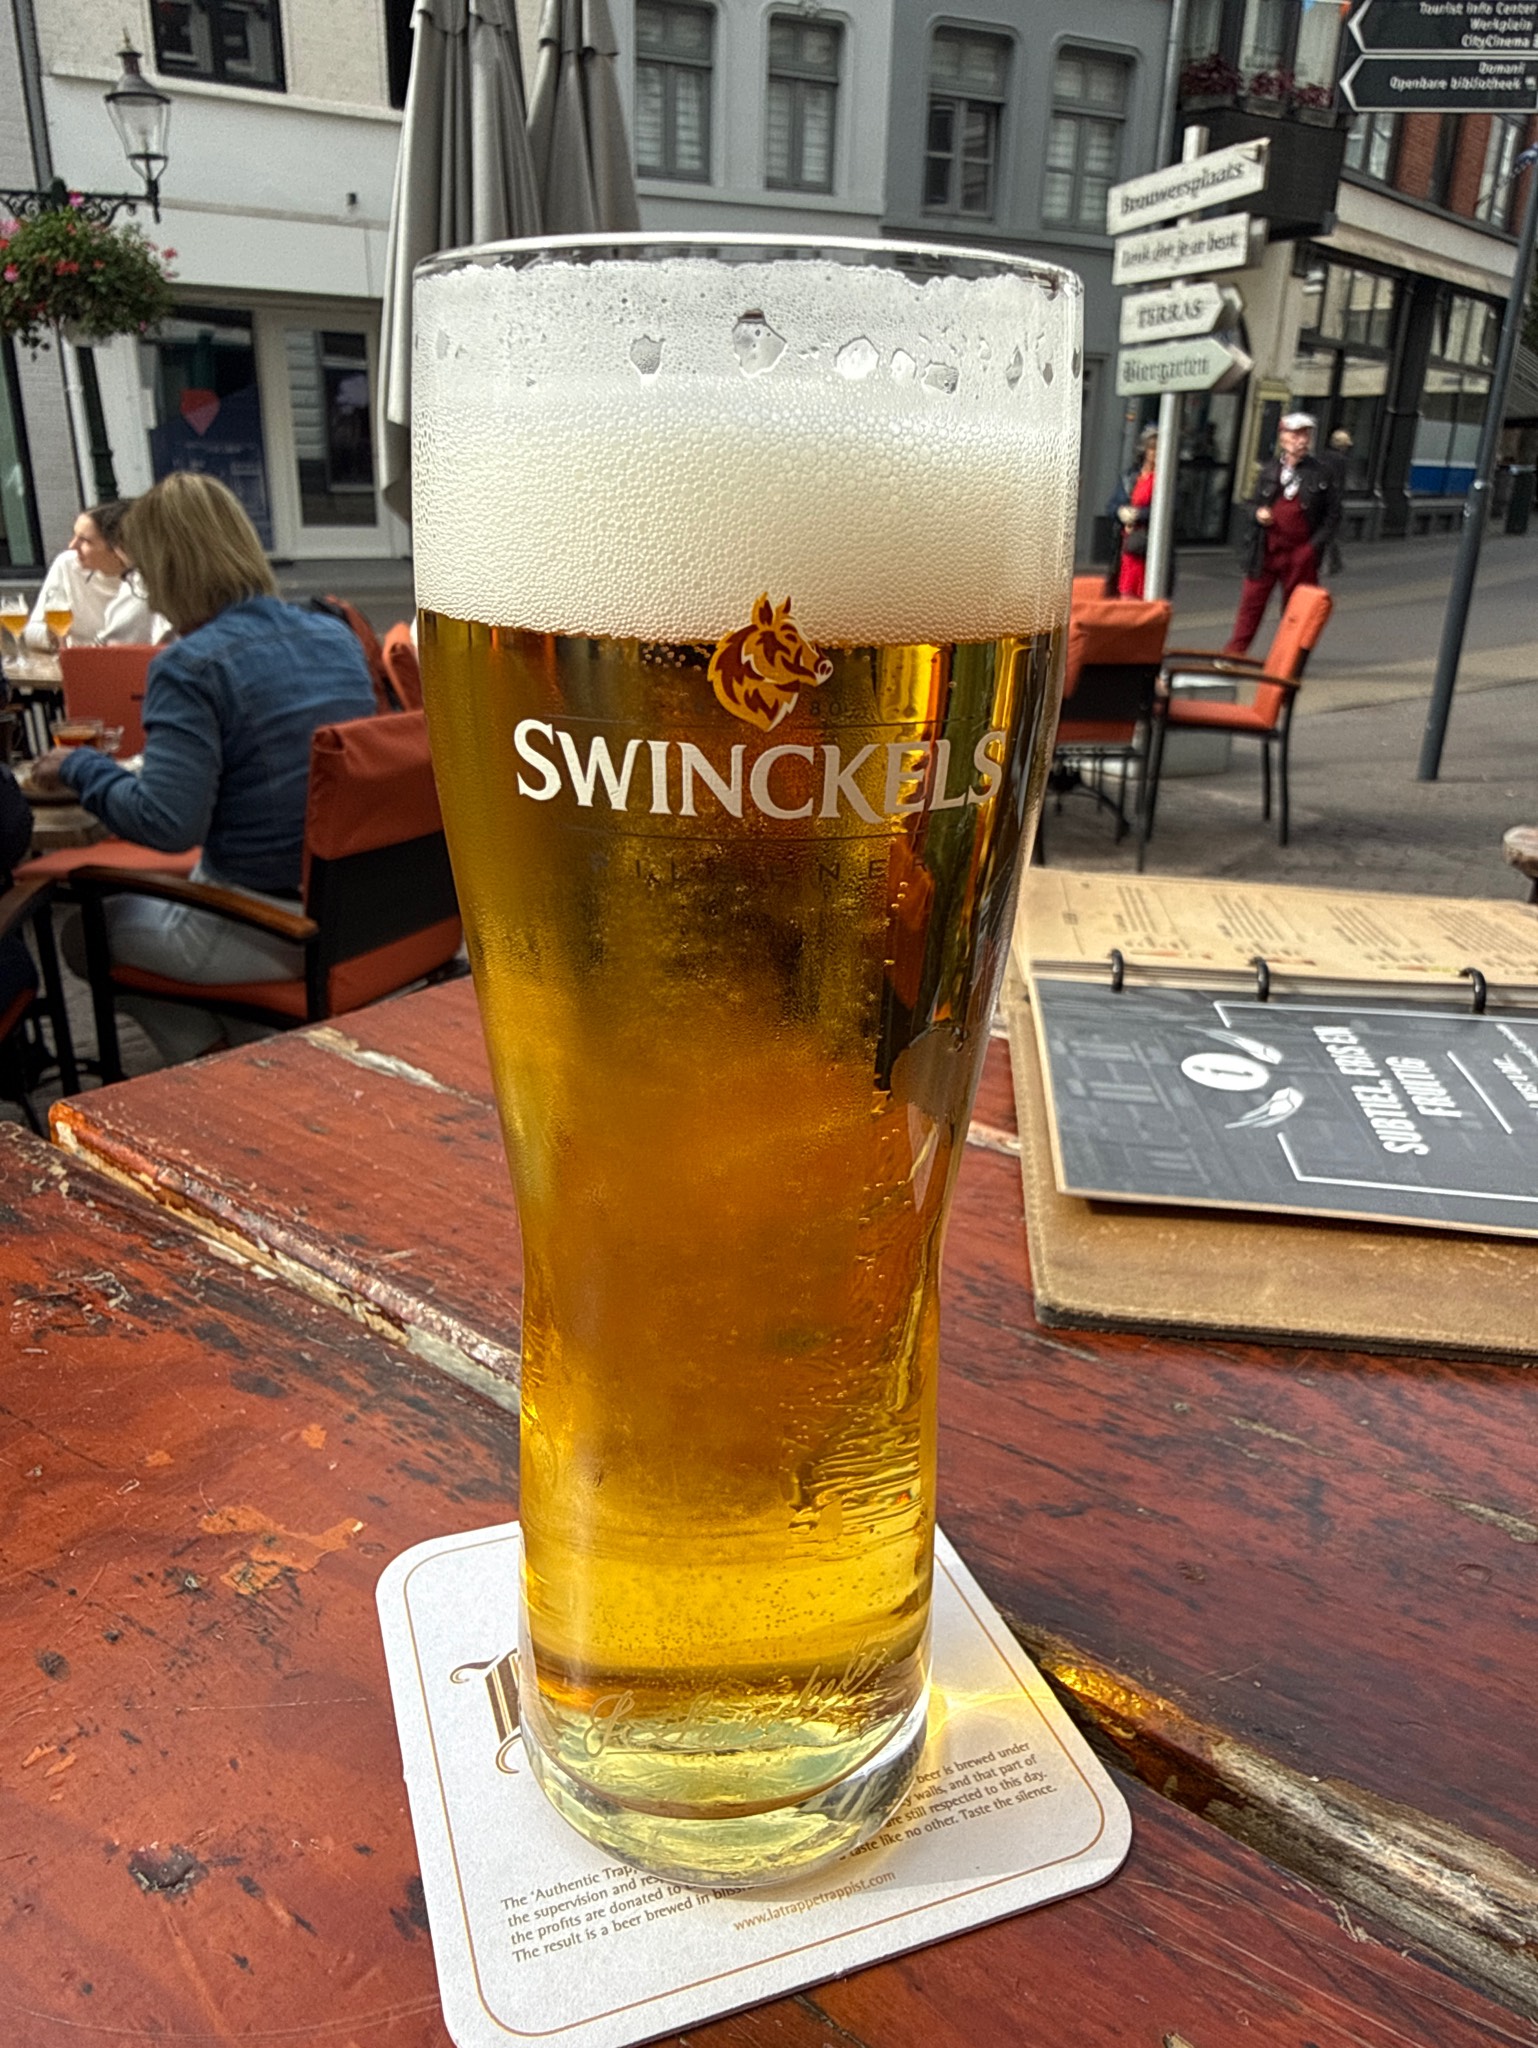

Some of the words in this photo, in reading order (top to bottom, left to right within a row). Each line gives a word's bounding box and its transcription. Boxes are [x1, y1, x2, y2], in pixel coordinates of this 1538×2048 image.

[1420, 1, 1463, 15] Tourist
[1495, 1, 1537, 15] Center
[1390, 76, 1448, 92] Openbare
[1451, 76, 1521, 90] bibliotheek
[1121, 162, 1245, 215] Brouwersplaats
[1138, 299, 1203, 330] TERRAS
[1123, 356, 1209, 385] Biergarten
[513, 718, 1008, 824] SWINCKELS
[1326, 1044, 1382, 1077] FRIS
[1385, 1056, 1462, 1118] FRUITIG
[1351, 1079, 1430, 1155] SUBTIEL,
[501, 1894, 527, 1911] The
[916, 1770, 942, 1783] beer
[944, 1764, 954, 1777] is
[954, 1752, 996, 1773] brewed
[999, 1741, 1031, 1759] under
[508, 1913, 531, 1927] the
[534, 1889, 609, 1919] supervision
[612, 1877, 637, 1898] and
[914, 1782, 948, 1801] walls,
[949, 1775, 971, 1791] and
[973, 1767, 998, 1784] that
[1000, 1760, 1024, 1778] part
[1025, 1754, 1038, 1766] of
[511, 1930, 534, 1945] the
[537, 1913, 582, 1942] profits
[585, 1908, 607, 1922] are
[609, 1889, 665, 1916] donated
[667, 1883, 682, 1899] to
[906, 1804, 928, 1822] still
[930, 1787, 984, 1814] respected
[985, 1782, 999, 1796] to
[1000, 1775, 1023, 1793] this
[1024, 1769, 1048, 1788] day.
[512, 1948, 540, 1963] The
[544, 1932, 583, 1953] result
[585, 1927, 598, 1941] is
[601, 1925, 610, 1937] a
[612, 1914, 641, 1933] beer
[644, 1895, 693, 1922] brewed
[697, 1891, 711, 1906] in
[881, 1829, 904, 1847] like
[905, 1825, 922, 1840] no
[924, 1813, 960, 1833] other.
[960, 1803, 992, 1822] Taste
[994, 1795, 1014, 1810] the
[1016, 1783, 1058, 1803] silence.
[734, 1870, 897, 1932] www.latrappetrappist.com
